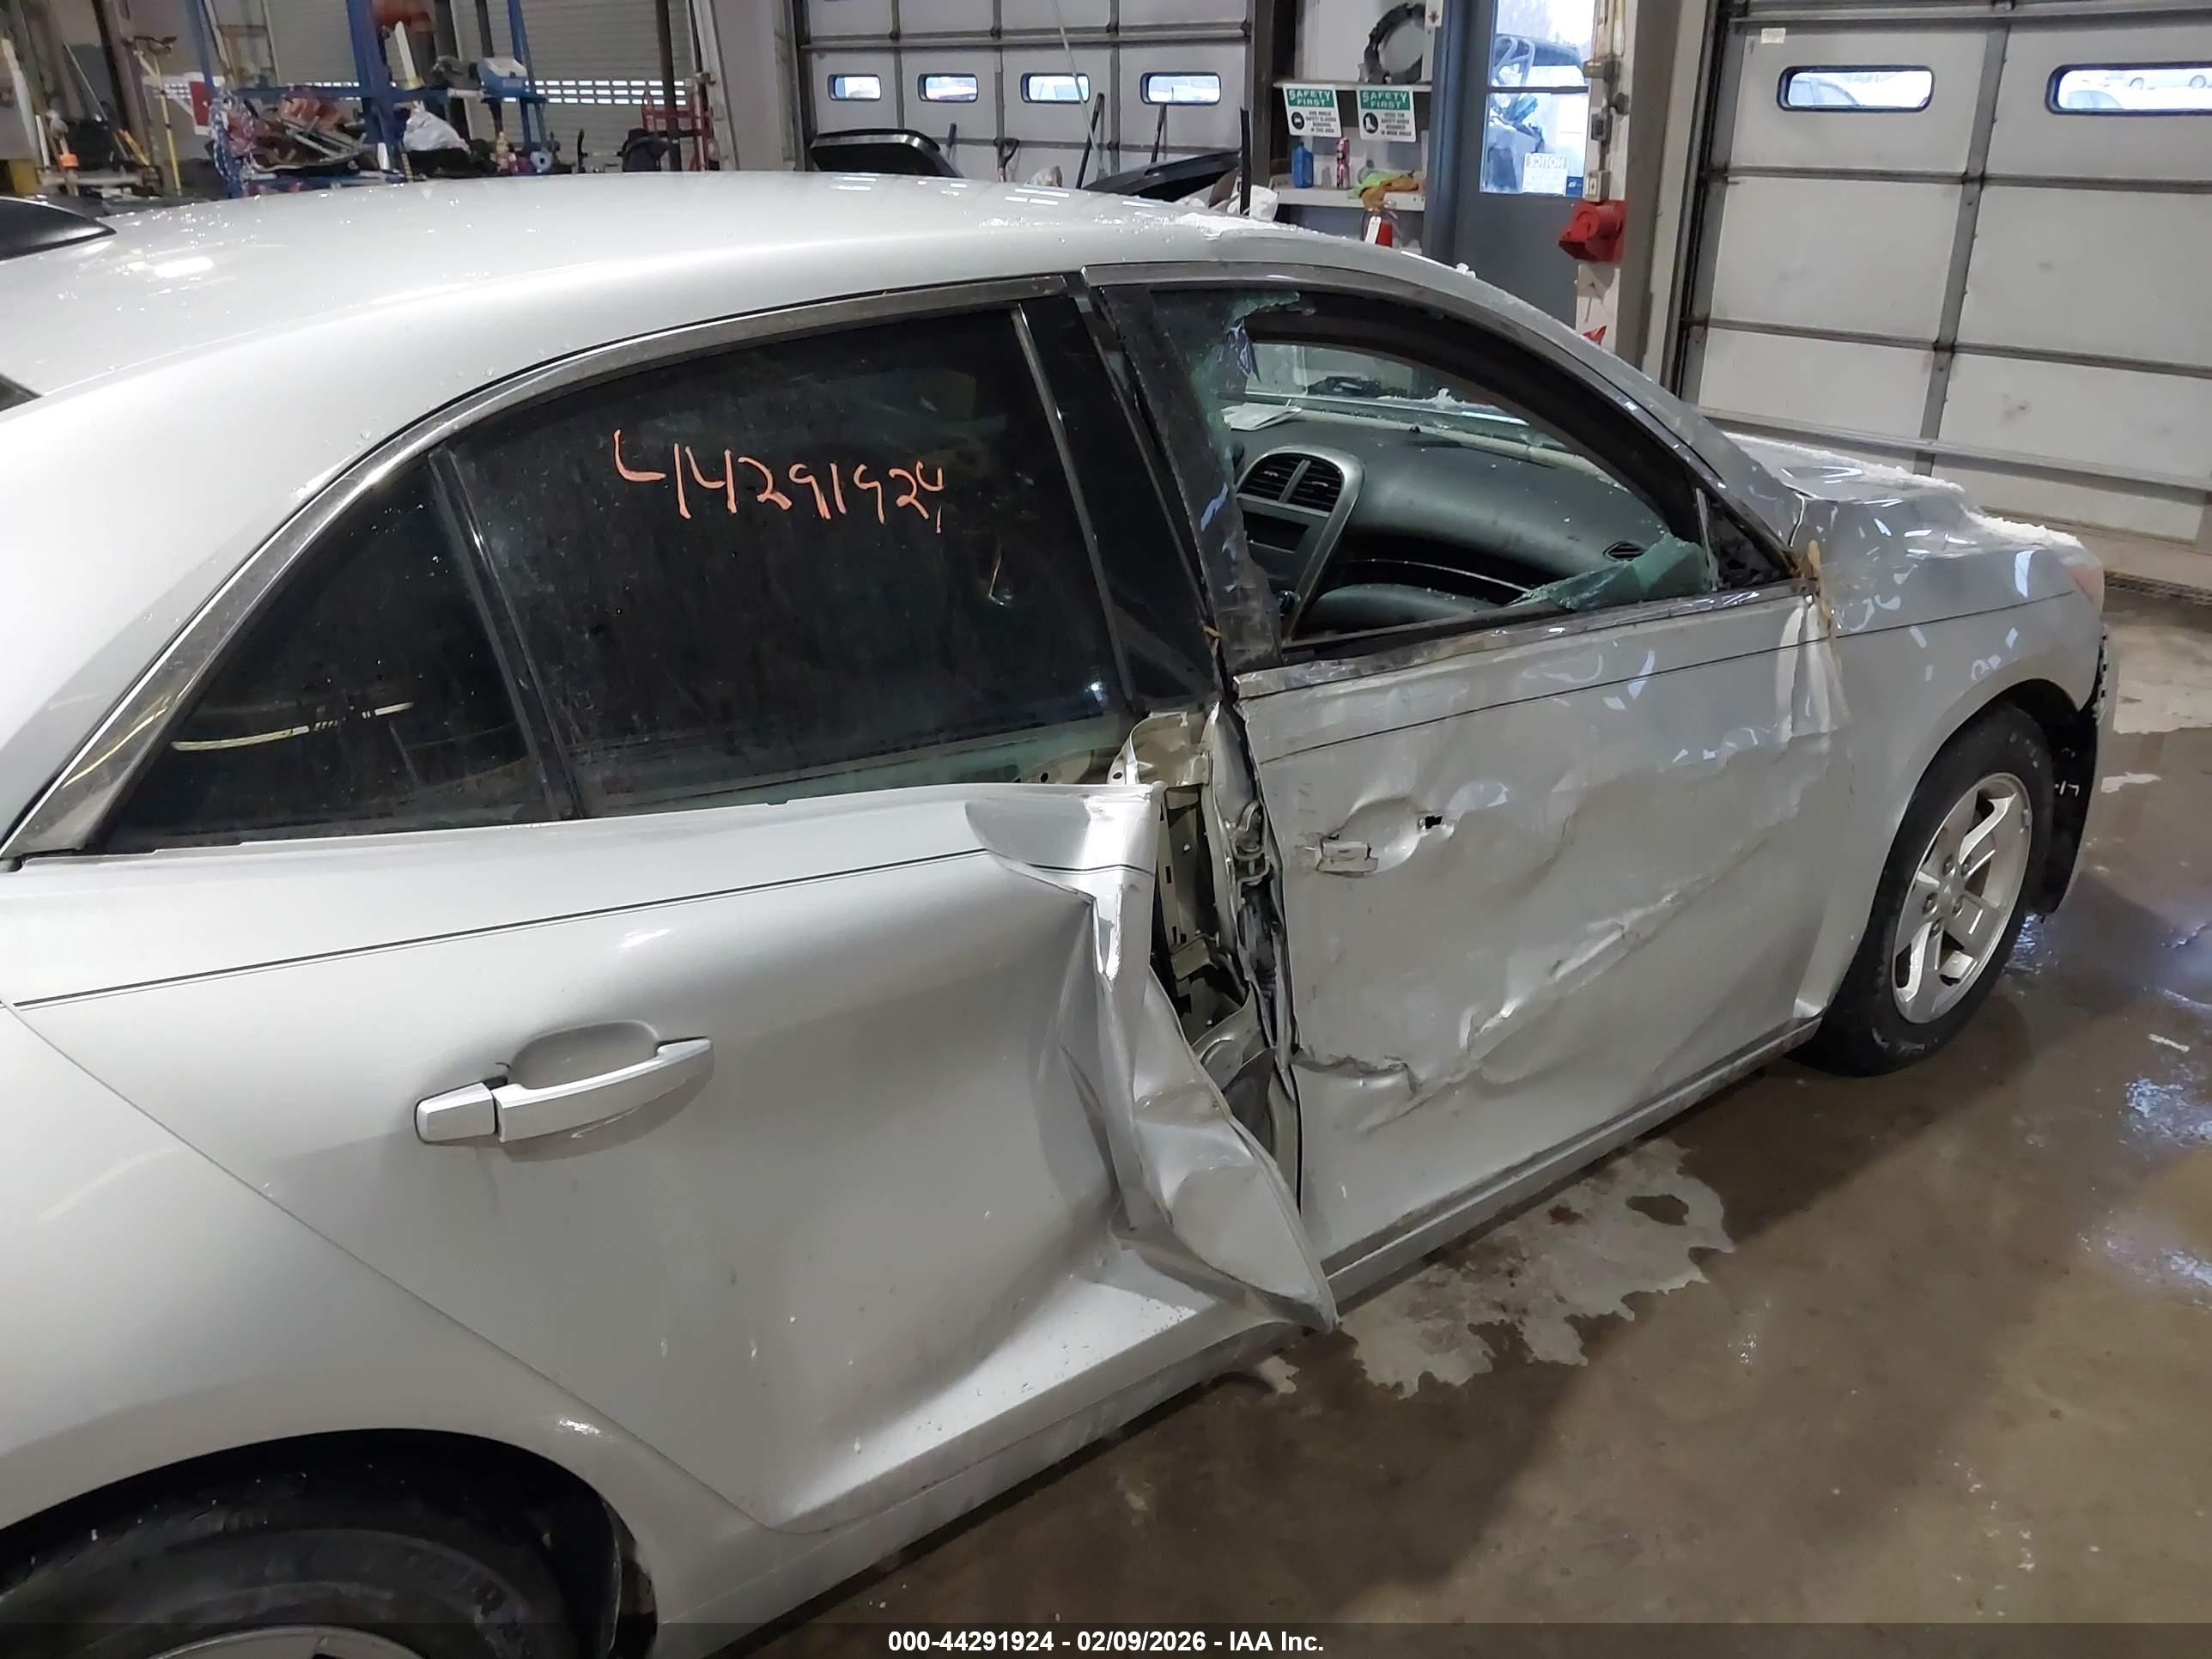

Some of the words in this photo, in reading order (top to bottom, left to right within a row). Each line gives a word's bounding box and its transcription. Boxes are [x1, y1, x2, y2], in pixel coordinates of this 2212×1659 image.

[1289, 89, 1330, 101] SAFETY
[1362, 91, 1407, 103] SAFETY
[1370, 100, 1401, 109] FIRST
[612, 429, 945, 533] 44291924
